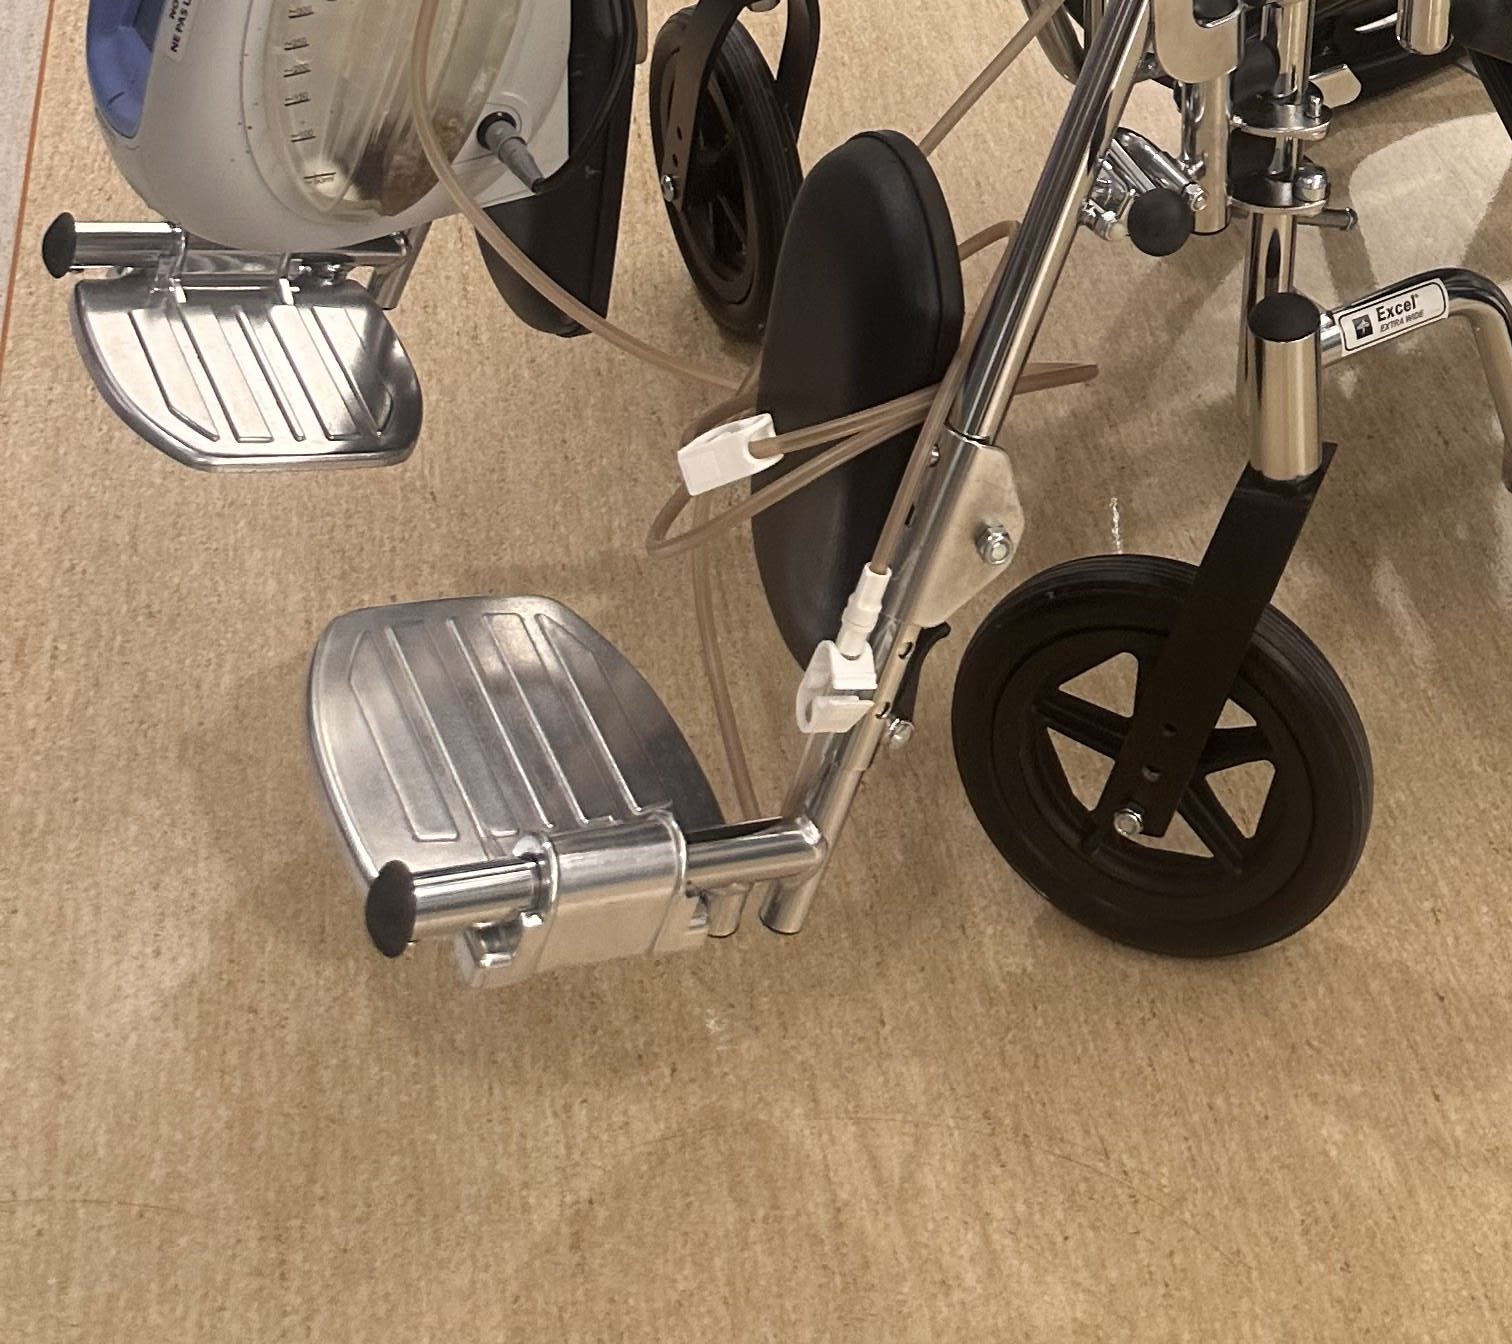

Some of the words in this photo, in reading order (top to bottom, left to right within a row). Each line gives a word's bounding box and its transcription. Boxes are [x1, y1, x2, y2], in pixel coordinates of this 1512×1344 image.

[170, 33, 182, 53] NE
[176, 8, 189, 33] PAS
[1376, 295, 1416, 322] Excel
[1380, 319, 1404, 332] EXTRA
[1405, 309, 1424, 323] WIDE
